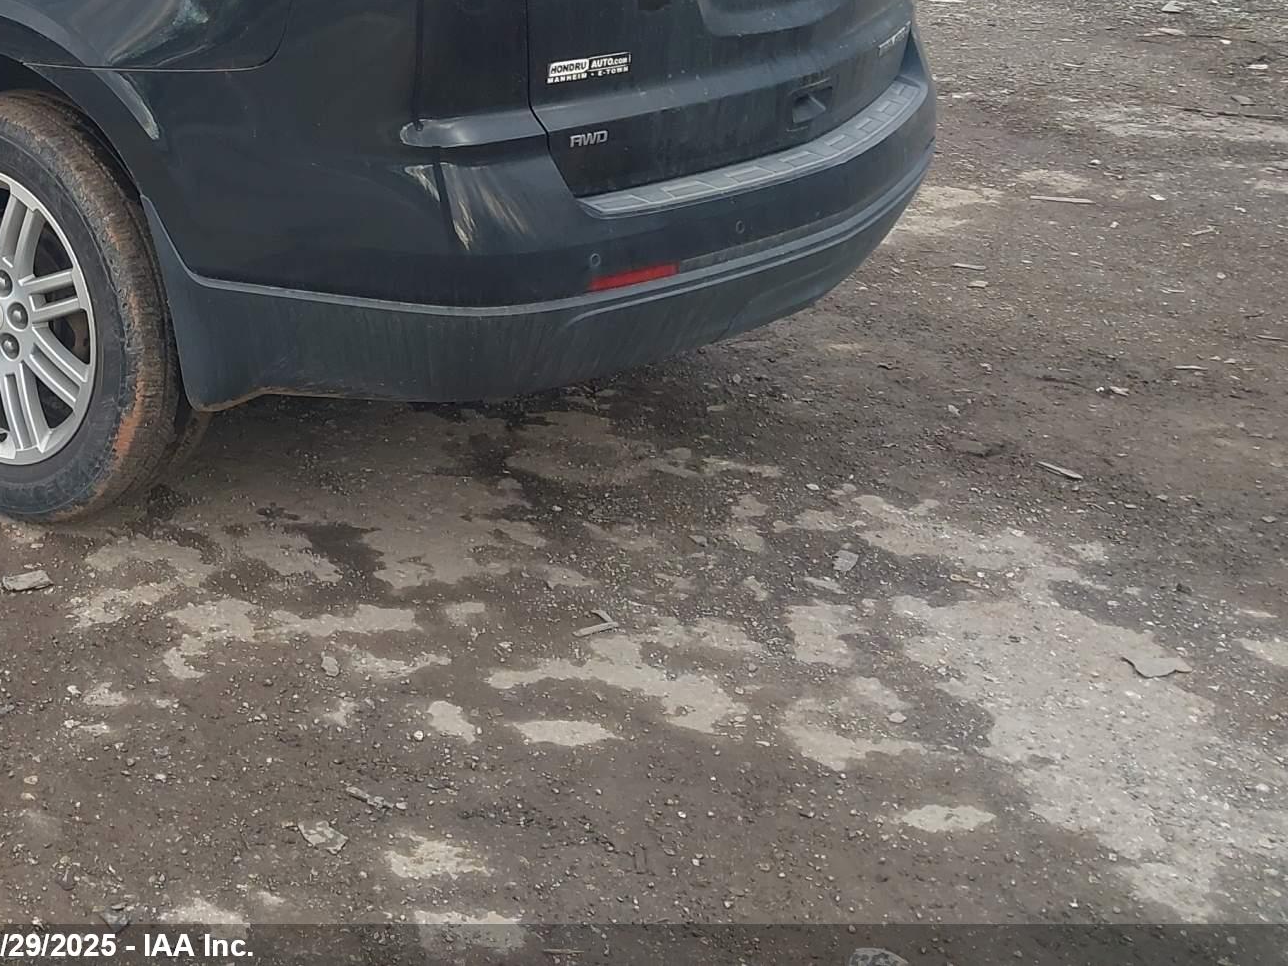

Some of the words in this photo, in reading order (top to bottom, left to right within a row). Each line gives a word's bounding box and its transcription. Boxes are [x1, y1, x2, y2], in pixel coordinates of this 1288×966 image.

[551, 62, 588, 74] HONDRU
[547, 72, 587, 84] MANHEIM
[569, 130, 608, 148] AWD
